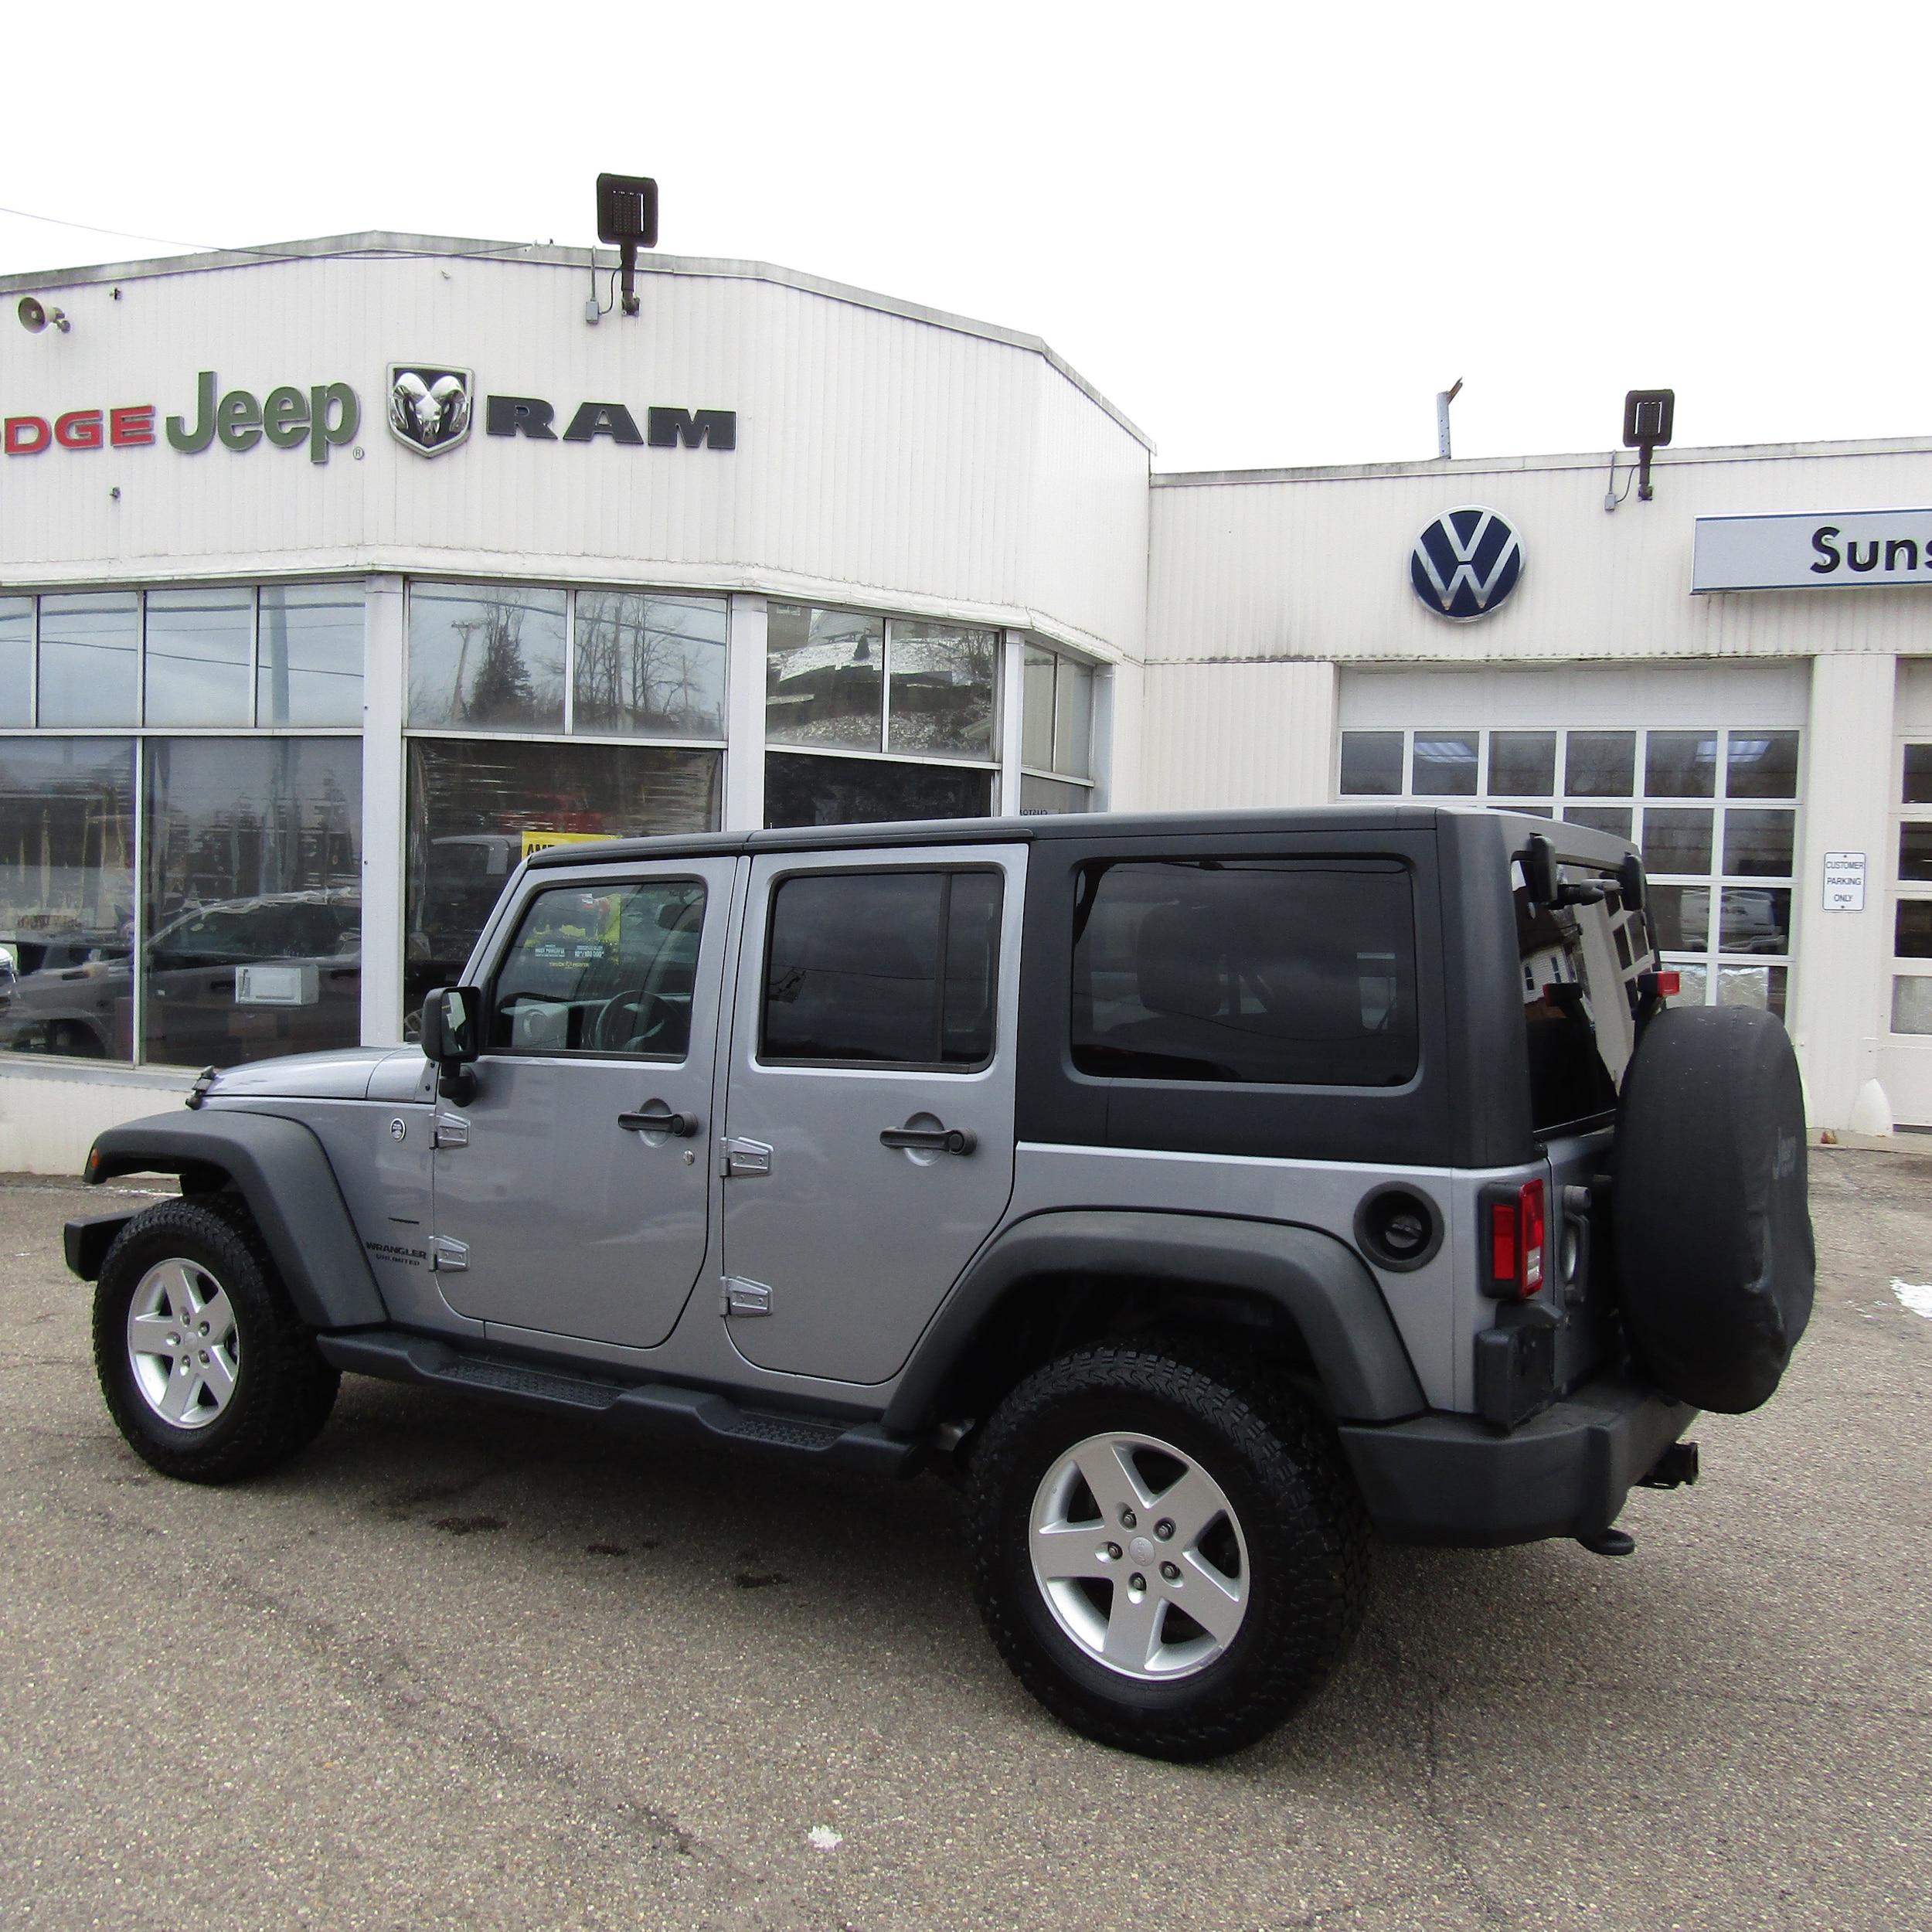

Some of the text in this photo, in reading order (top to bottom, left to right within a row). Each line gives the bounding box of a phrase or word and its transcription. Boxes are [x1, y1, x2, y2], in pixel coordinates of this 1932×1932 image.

[0, 406, 155, 455] DGE
[486, 395, 737, 449] RAM
[1834, 893, 1854, 902] ONLY
[366, 1241, 427, 1260] WRANGLER
[376, 1253, 420, 1266] UNLIMITED
